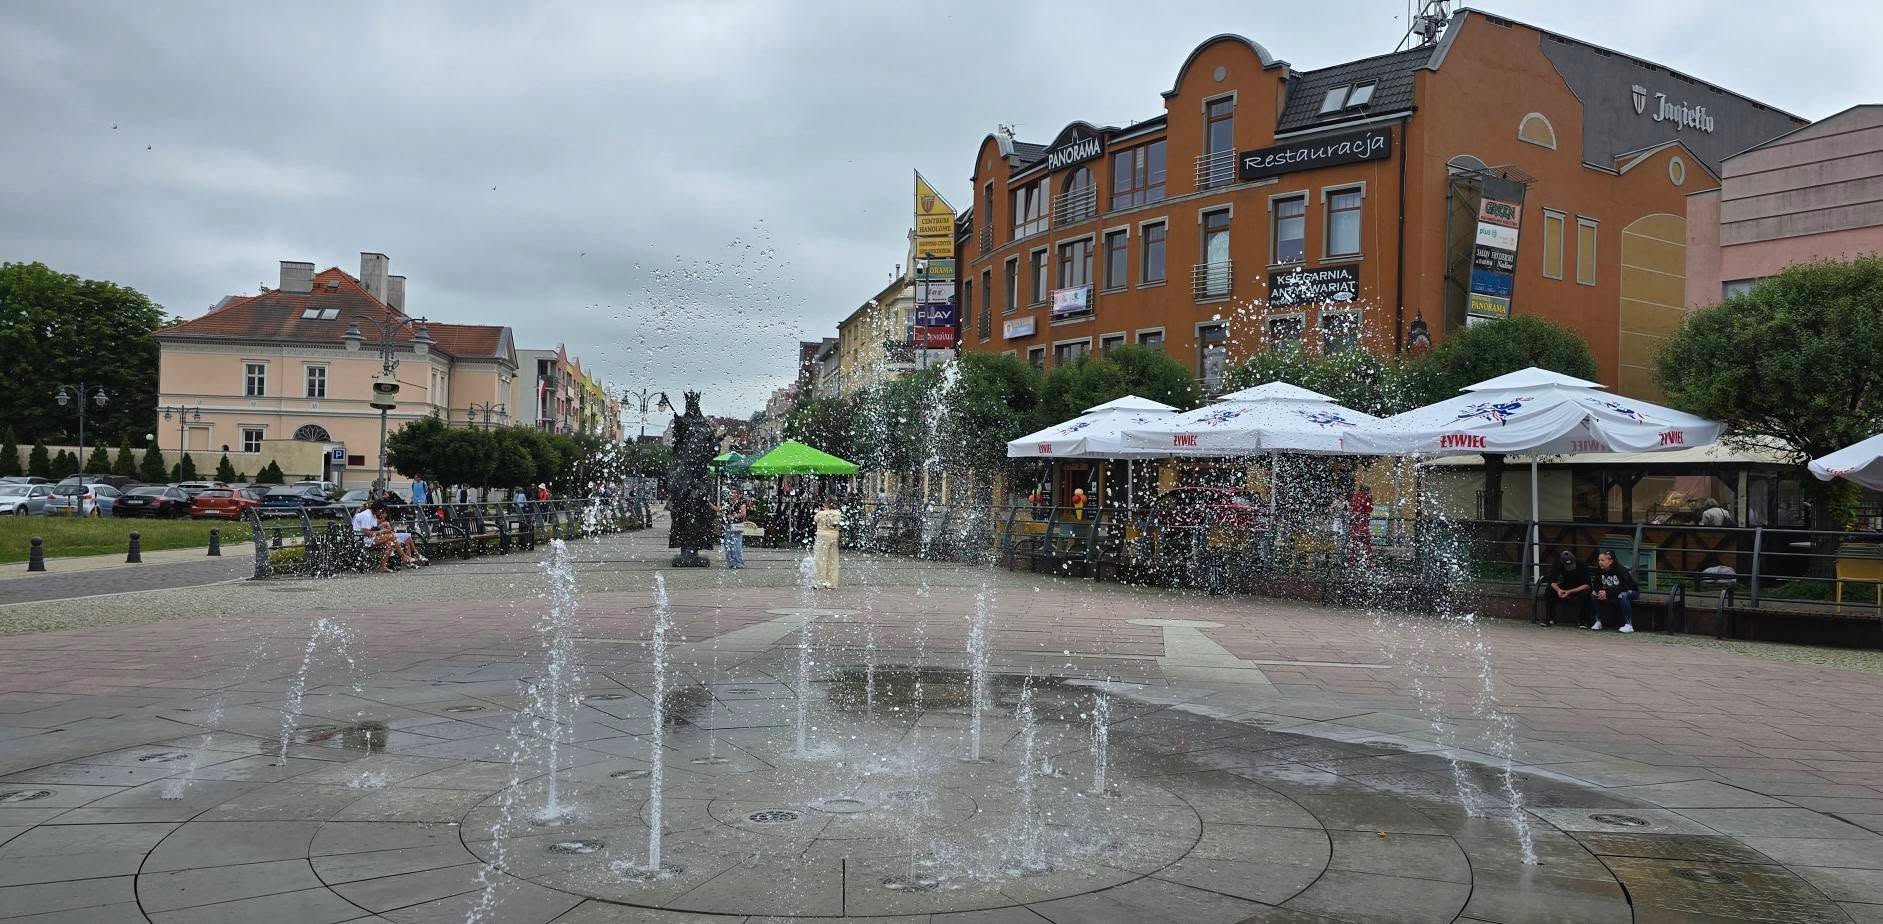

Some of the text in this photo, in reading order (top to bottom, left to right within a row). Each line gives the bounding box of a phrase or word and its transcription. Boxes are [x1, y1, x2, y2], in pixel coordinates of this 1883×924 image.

[1048, 137, 1101, 170] PANORAMA
[1244, 132, 1385, 171] Restauracja
[921, 217, 951, 225] CENTRUM
[1479, 227, 1491, 237] plus
[1271, 281, 1356, 299] ANTYKWARIAT
[1471, 300, 1506, 314] PANORAMA
[918, 310, 952, 319] PLAY
[1173, 433, 1198, 447] ŻYWIEC
[1440, 434, 1487, 449] ŻYWIEC
